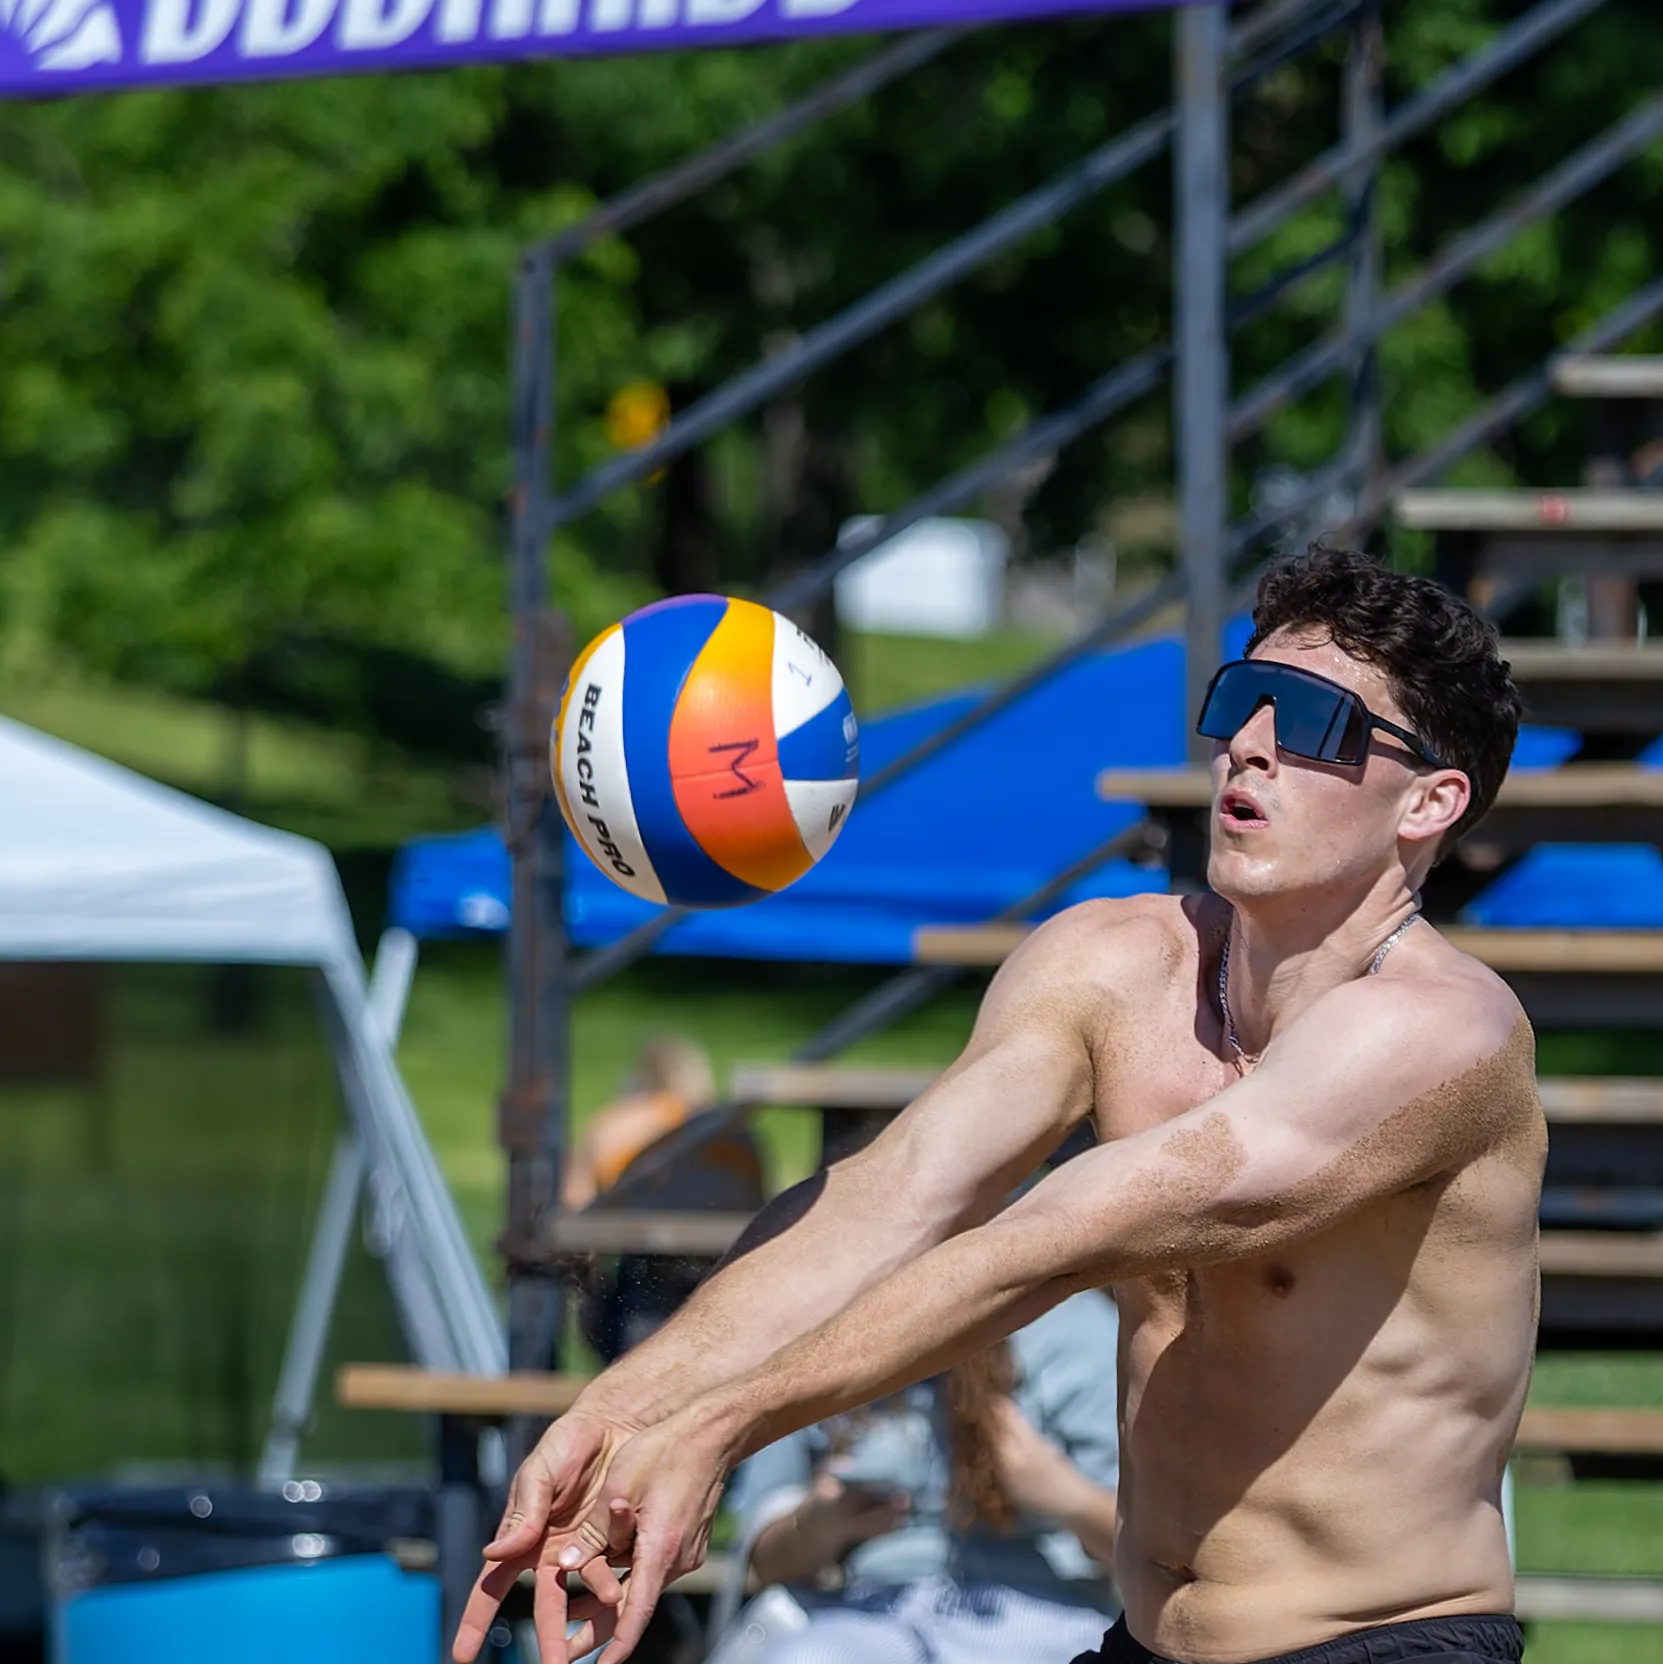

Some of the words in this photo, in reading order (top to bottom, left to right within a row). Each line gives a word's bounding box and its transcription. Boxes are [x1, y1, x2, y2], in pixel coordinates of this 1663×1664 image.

[577, 682, 602, 808] BEACH
[708, 737, 766, 800] M
[587, 813, 636, 878] PRO
